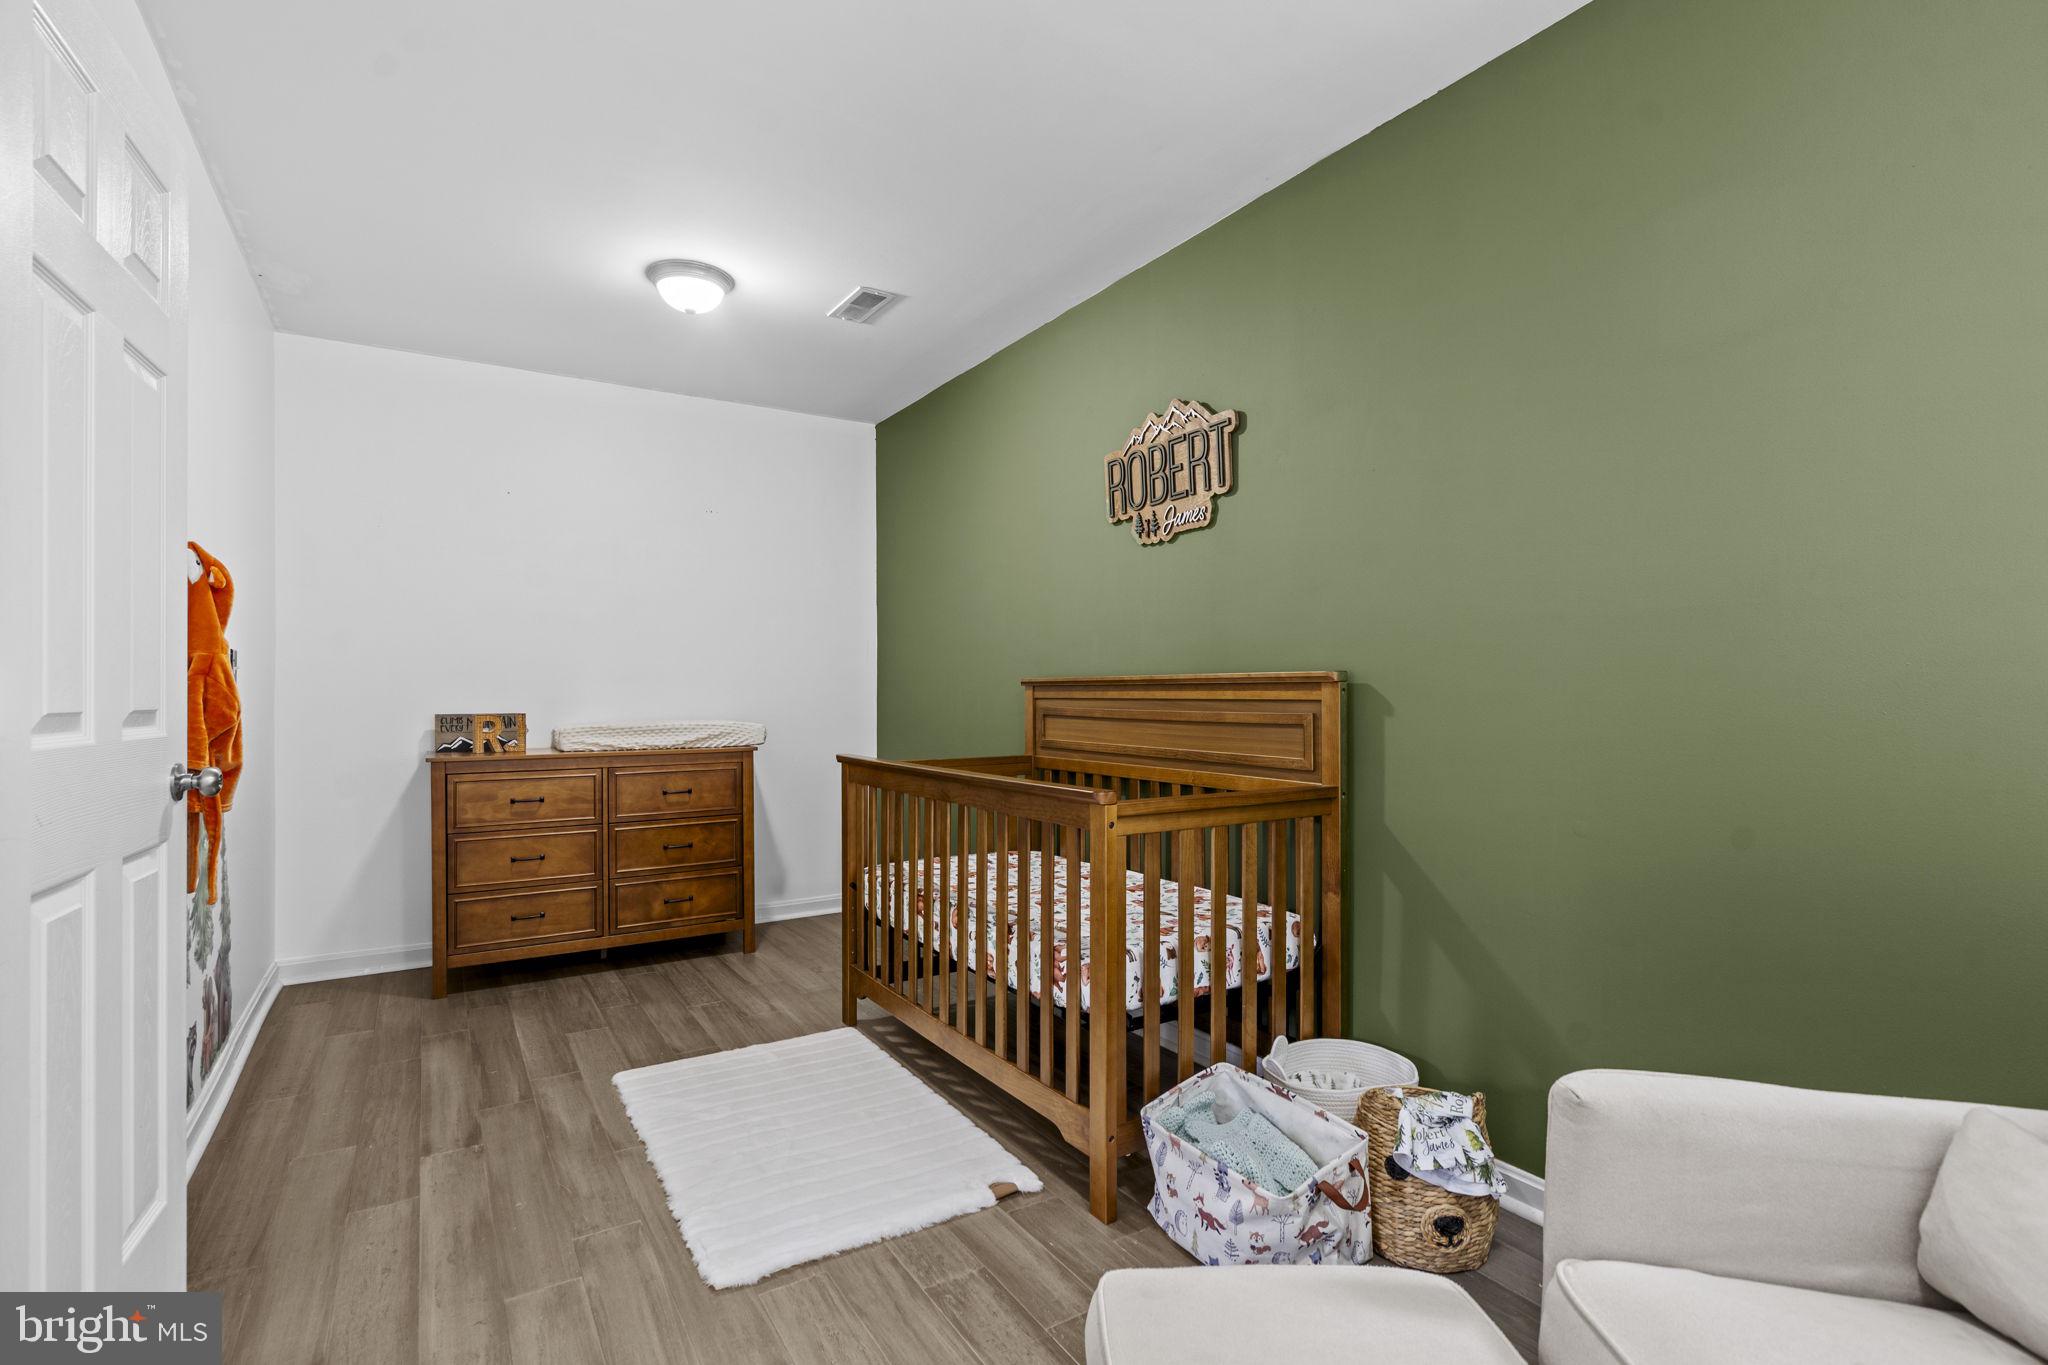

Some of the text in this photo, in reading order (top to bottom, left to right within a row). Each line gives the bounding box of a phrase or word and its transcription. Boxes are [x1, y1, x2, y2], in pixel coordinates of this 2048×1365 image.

[1107, 417, 1231, 518] ROBERT
[1163, 504, 1207, 535] James
[440, 716, 464, 725] CLIMB
[440, 725, 464, 733] EVERY
[1423, 1138, 1455, 1155] James
